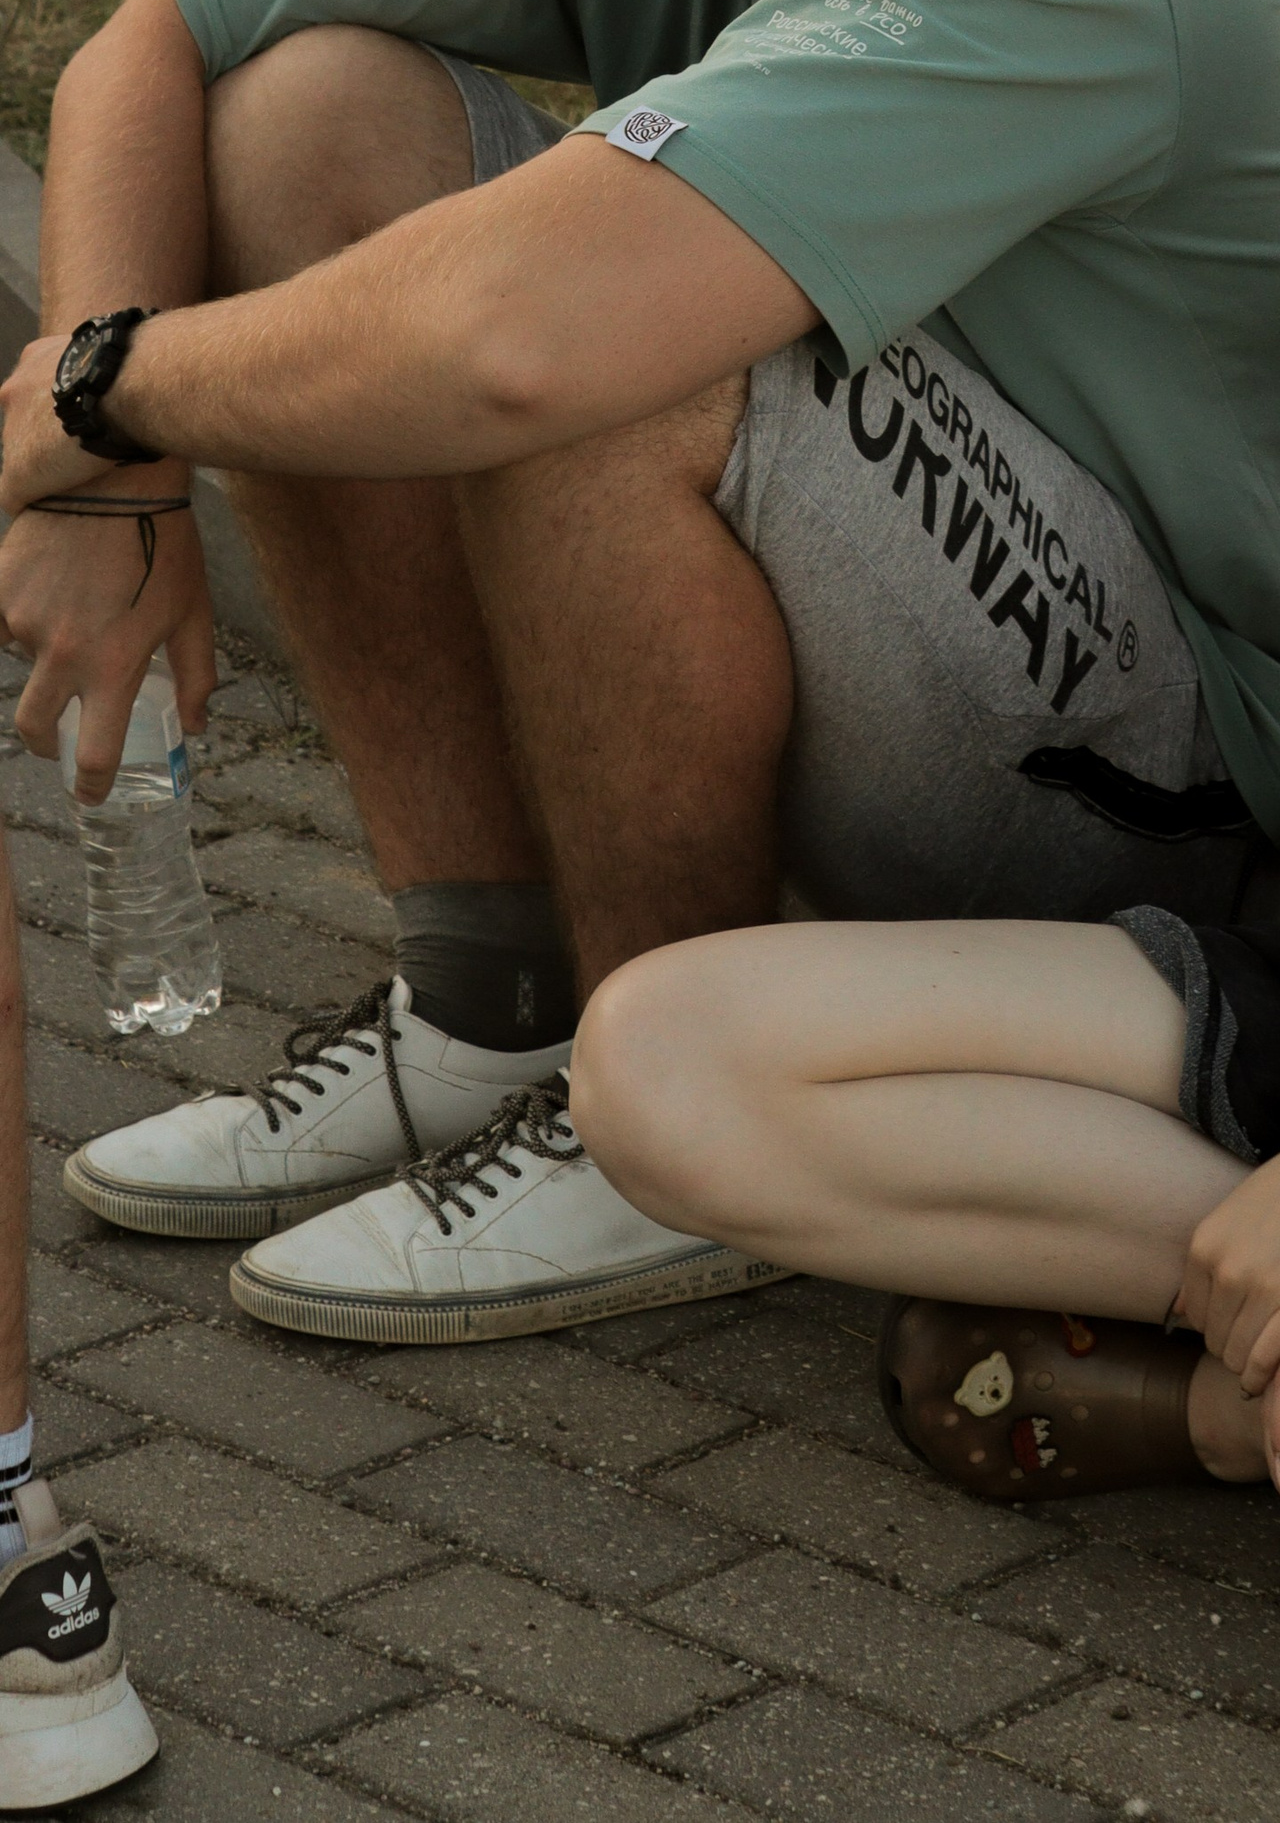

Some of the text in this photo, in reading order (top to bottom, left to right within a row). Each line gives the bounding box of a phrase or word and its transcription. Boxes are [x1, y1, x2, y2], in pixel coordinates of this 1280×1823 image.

[879, 337, 1113, 644] EOGRAPHICAL
[711, 1267, 735, 1279] BEST
[47, 1606, 100, 1640] adidas
